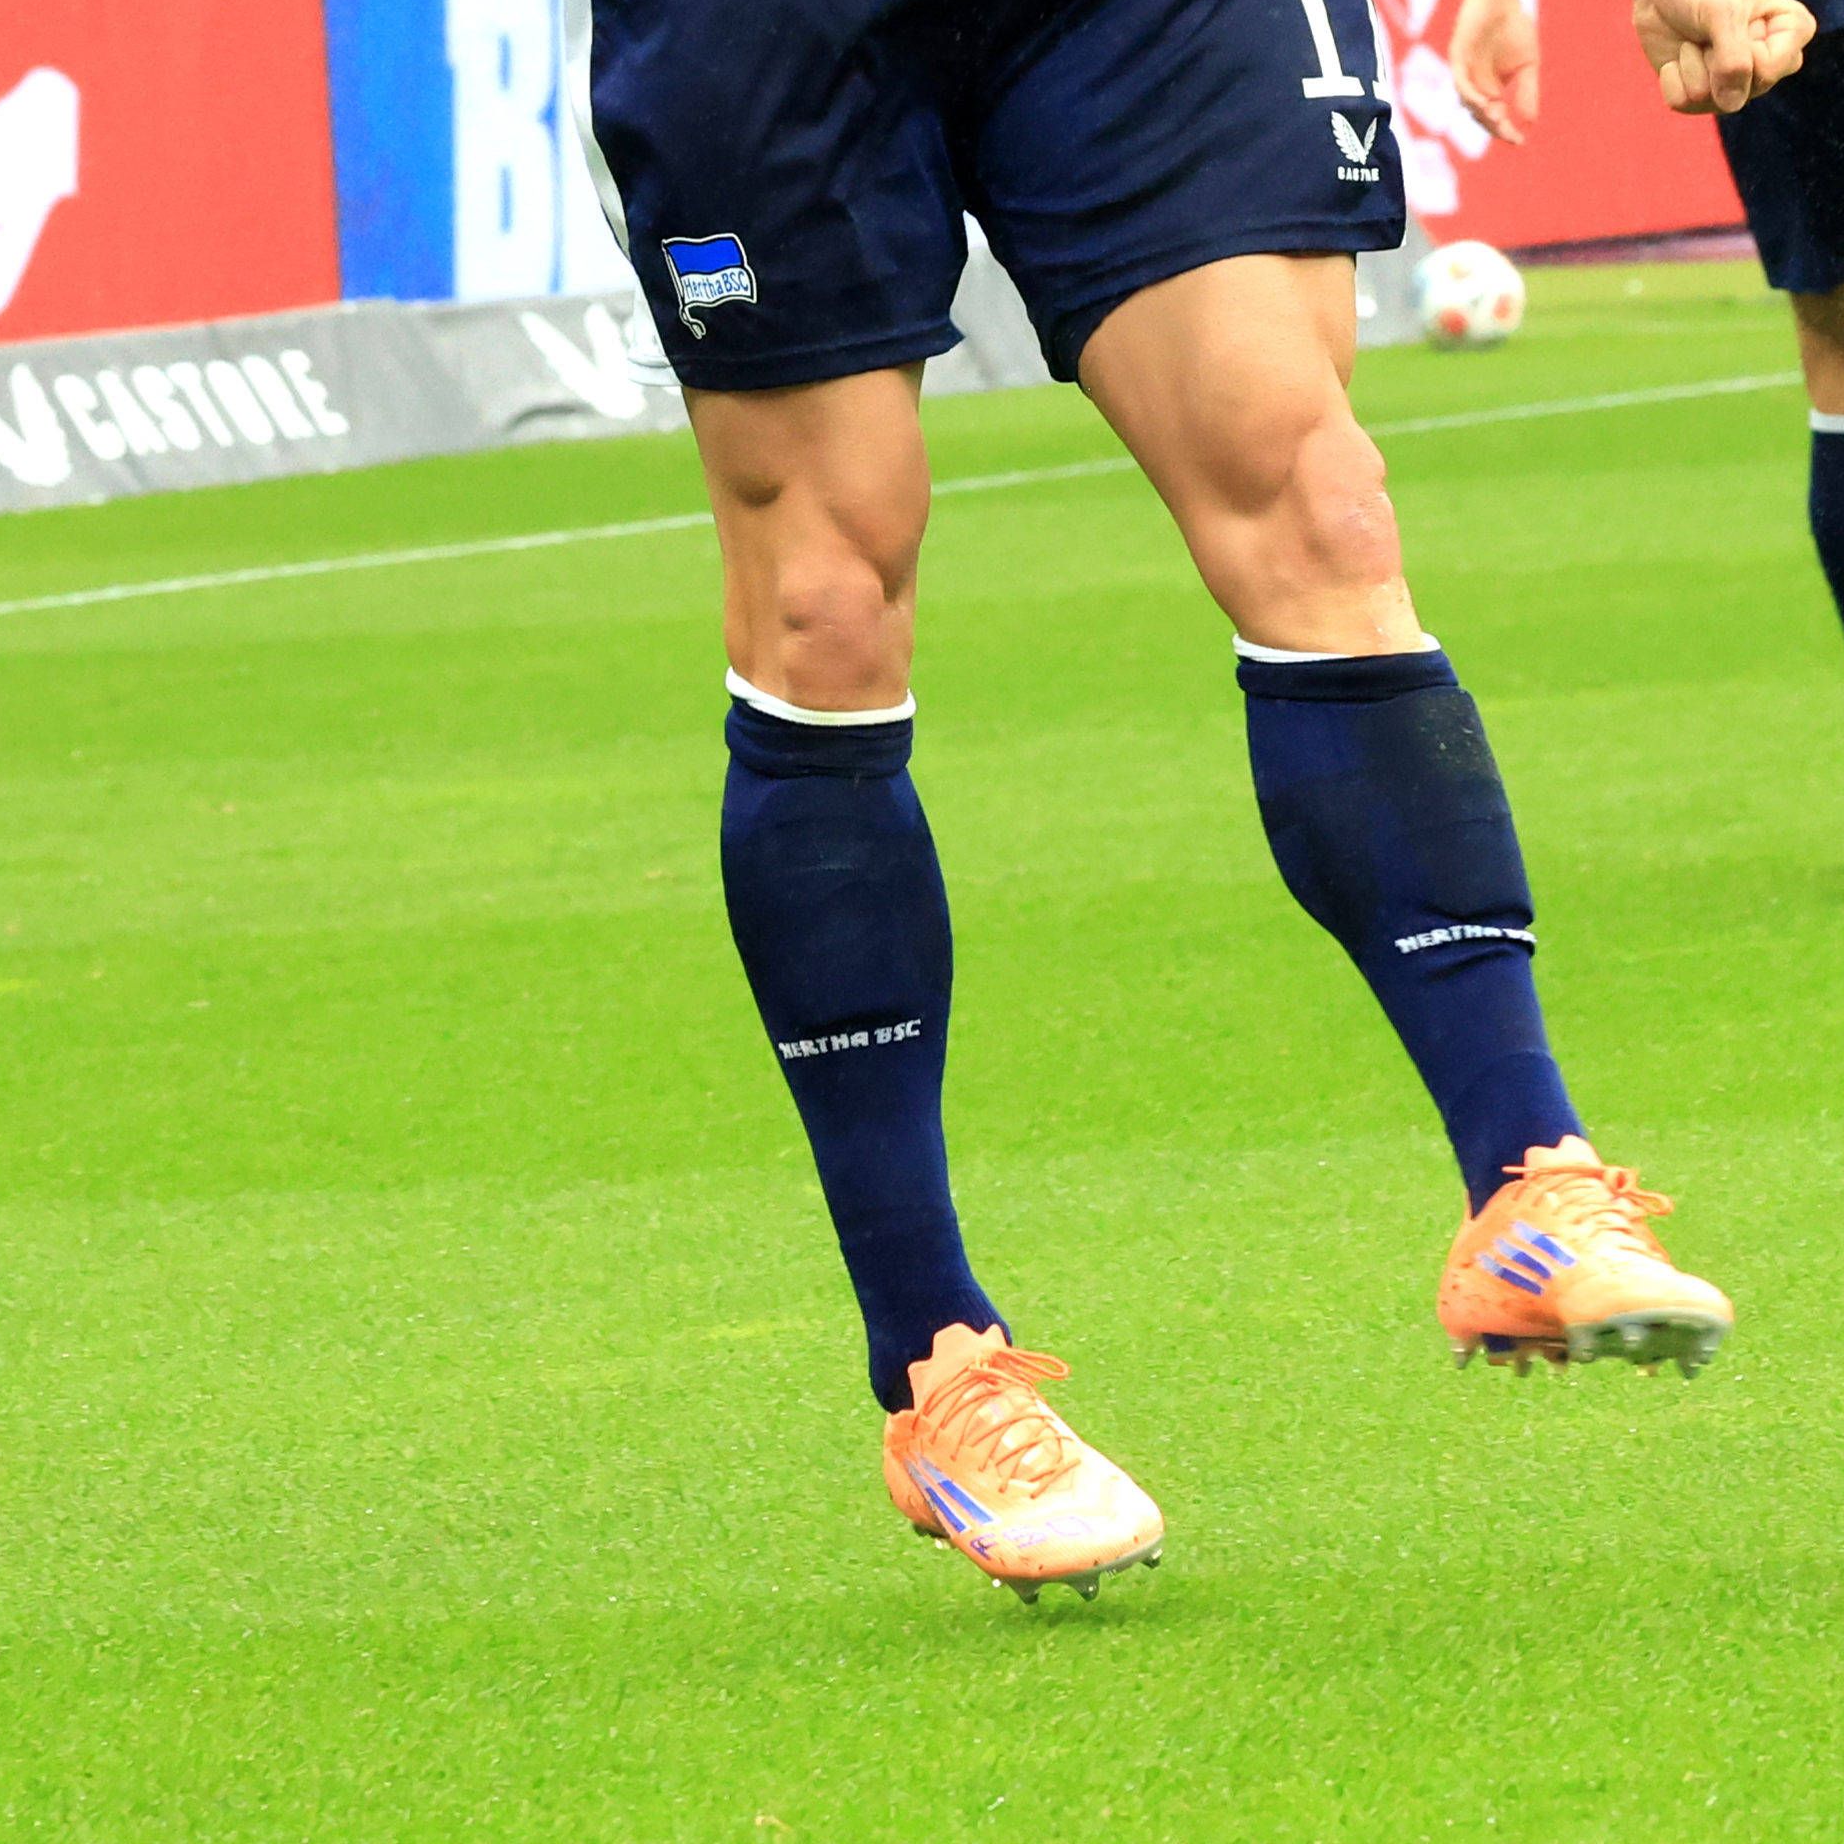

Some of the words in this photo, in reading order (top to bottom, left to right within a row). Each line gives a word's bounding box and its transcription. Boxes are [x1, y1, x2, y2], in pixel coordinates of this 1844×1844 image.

[55, 348, 349, 462] CASTORE
[778, 1030, 870, 1060] HERTHA
[873, 1018, 922, 1045] BSC
